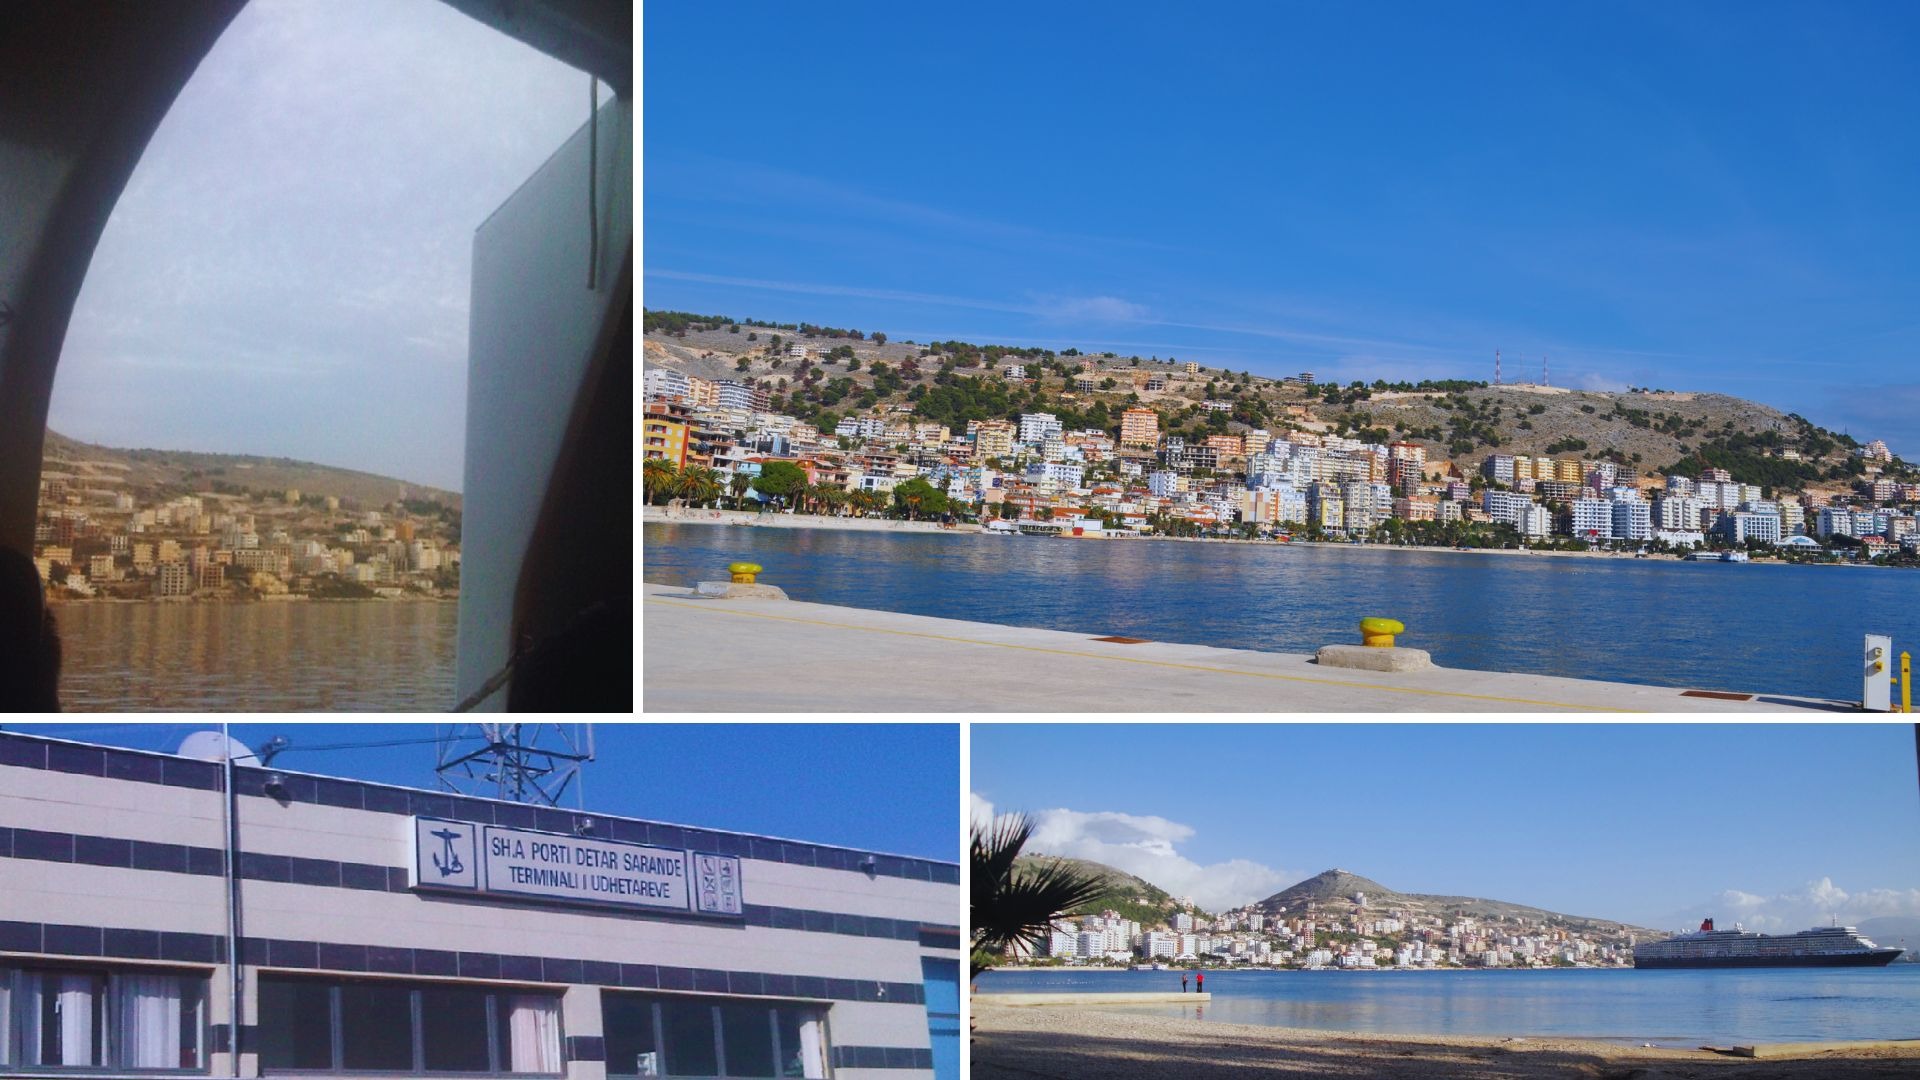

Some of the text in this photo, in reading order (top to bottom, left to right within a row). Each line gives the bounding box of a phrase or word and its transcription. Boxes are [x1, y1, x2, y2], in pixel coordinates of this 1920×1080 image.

[492, 836, 682, 878] SH.A PORTI DETAR SARANDE
[509, 866, 670, 898] TERMINALI I UDHETAREVE
